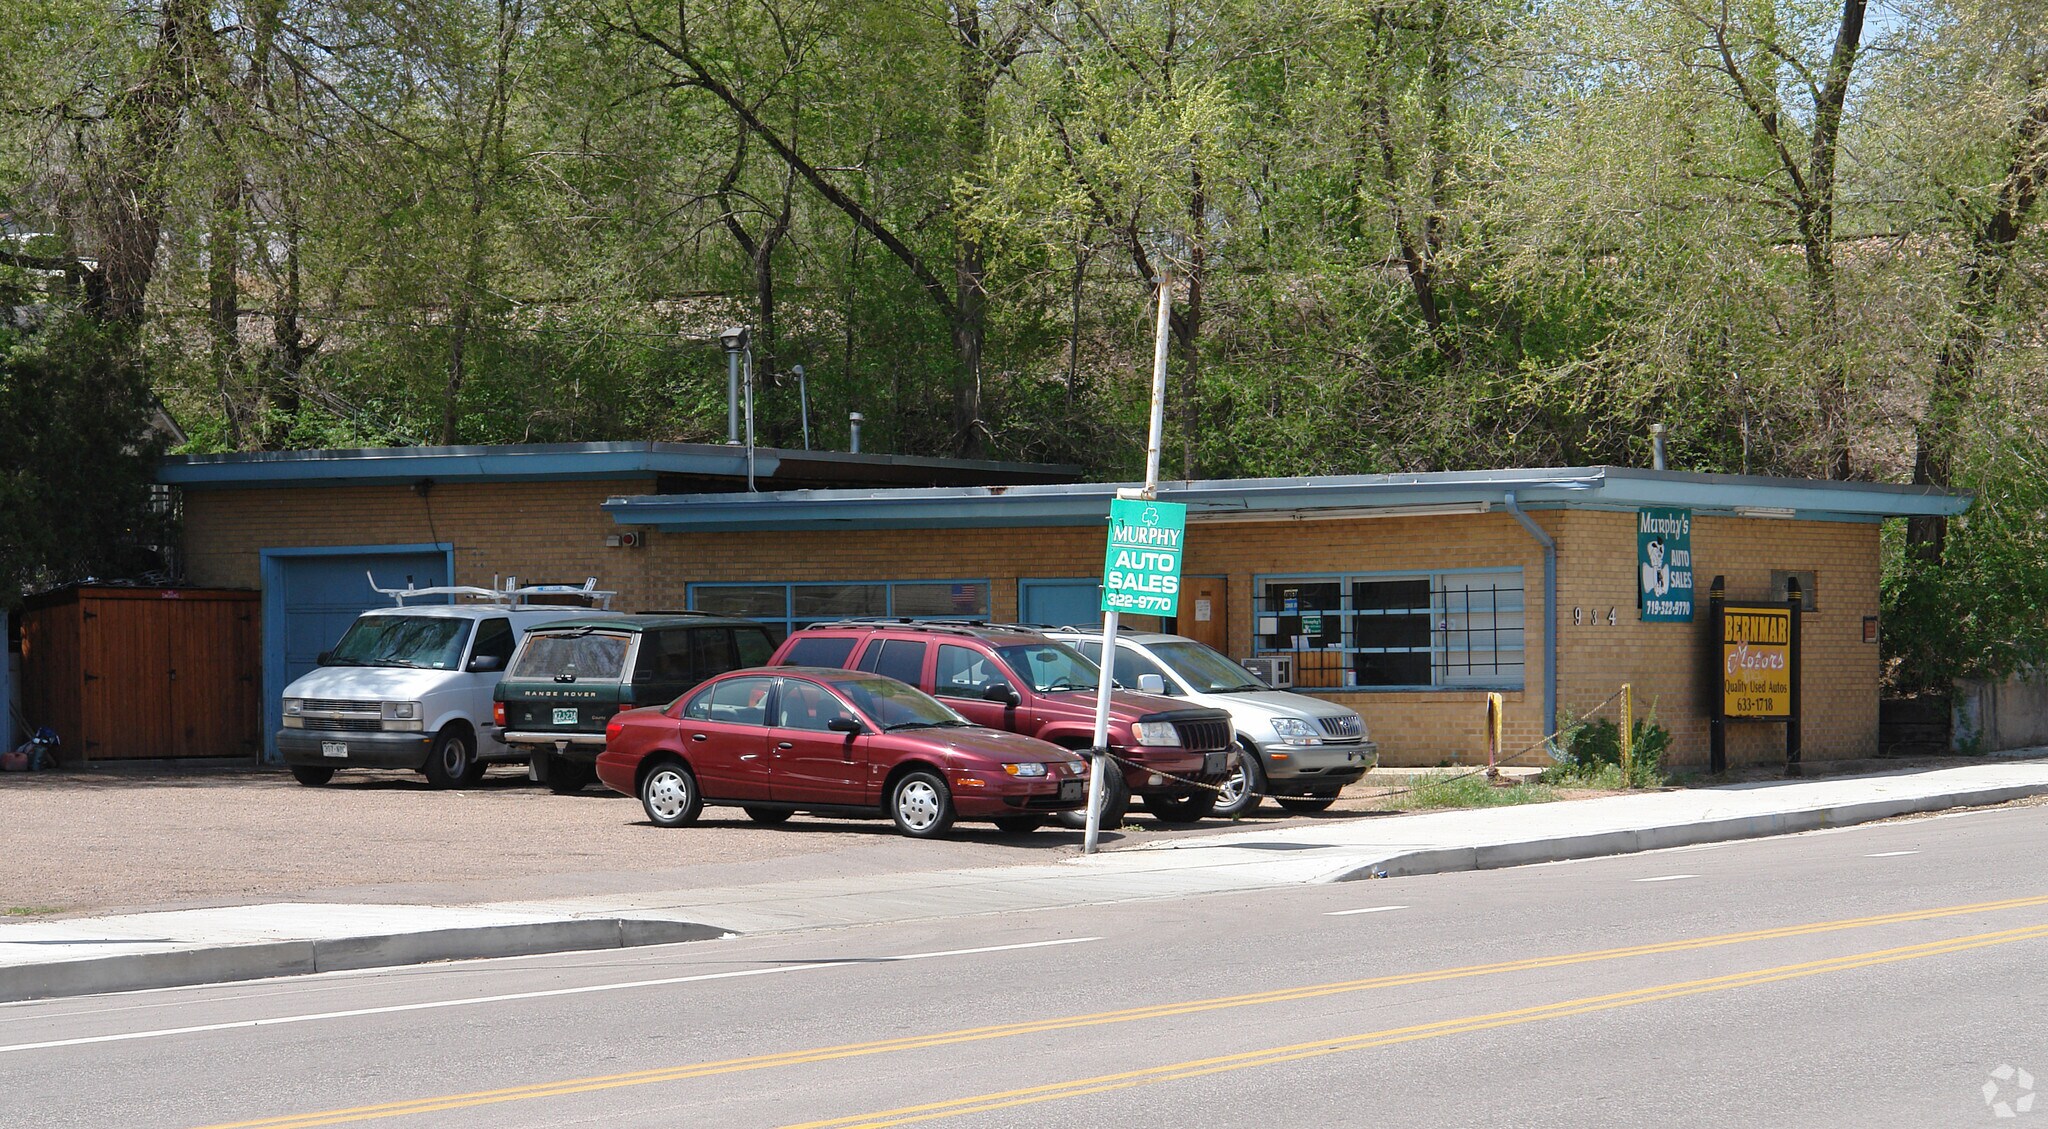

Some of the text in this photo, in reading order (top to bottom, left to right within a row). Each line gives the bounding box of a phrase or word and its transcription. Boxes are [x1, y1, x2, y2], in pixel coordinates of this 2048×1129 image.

[1113, 525, 1181, 546] MURPHY
[1640, 512, 1689, 540] Murphy's
[1115, 550, 1175, 572] AUTO
[1671, 549, 1690, 567] AUTO
[1108, 571, 1178, 594] SALES
[1670, 571, 1692, 589] SALES
[1107, 593, 1172, 611] 322-9770
[1724, 615, 1787, 643] BERNMAR
[1727, 643, 1784, 674] Motors
[1725, 679, 1788, 696] Quality Used Autos
[1737, 697, 1774, 711] 633-1718
